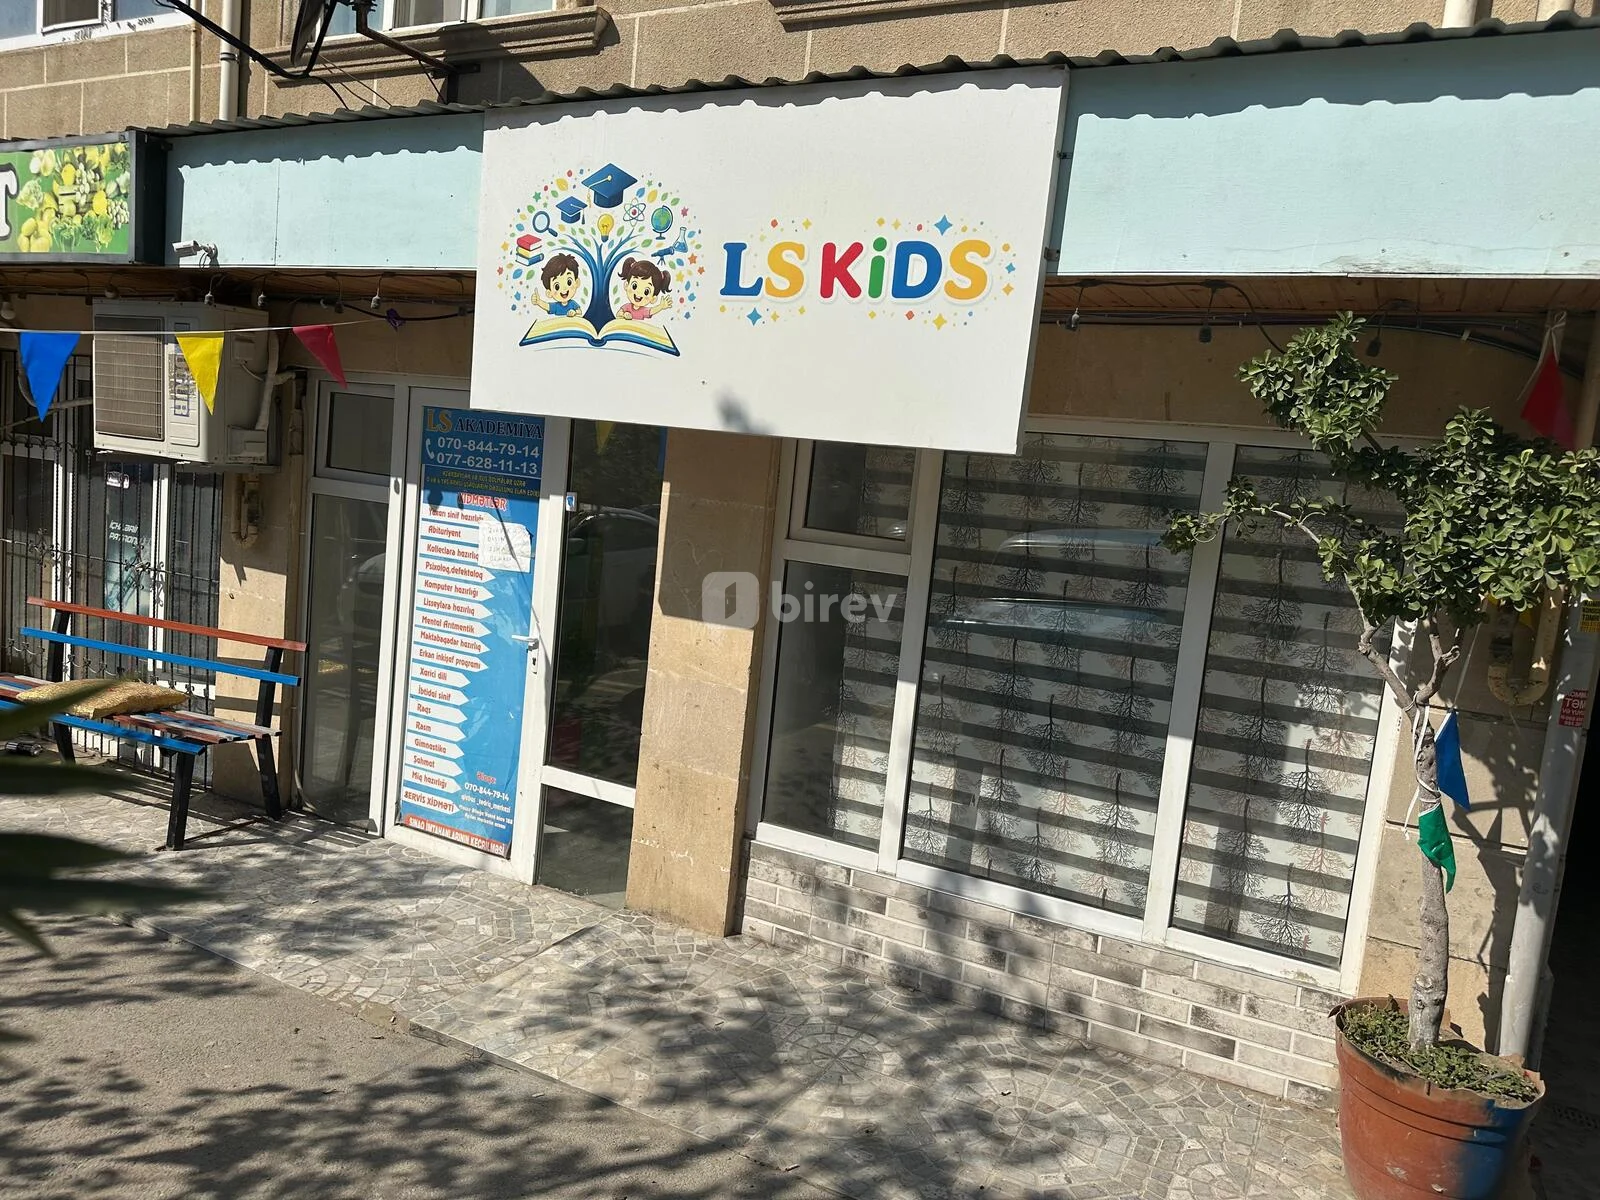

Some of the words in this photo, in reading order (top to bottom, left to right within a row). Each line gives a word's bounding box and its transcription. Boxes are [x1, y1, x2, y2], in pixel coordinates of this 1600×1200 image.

[719, 241, 806, 298] LS
[426, 408, 453, 433] LS
[455, 417, 544, 439] AKADEMİYA
[437, 436, 540, 458] 070-844-79-14
[436, 452, 538, 475] 077-628-11-13
[420, 667, 437, 678] Xarici
[414, 738, 447, 754] Gimnastika
[403, 790, 425, 803] SERVİS
[464, 782, 509, 801] 070-844-79-14
